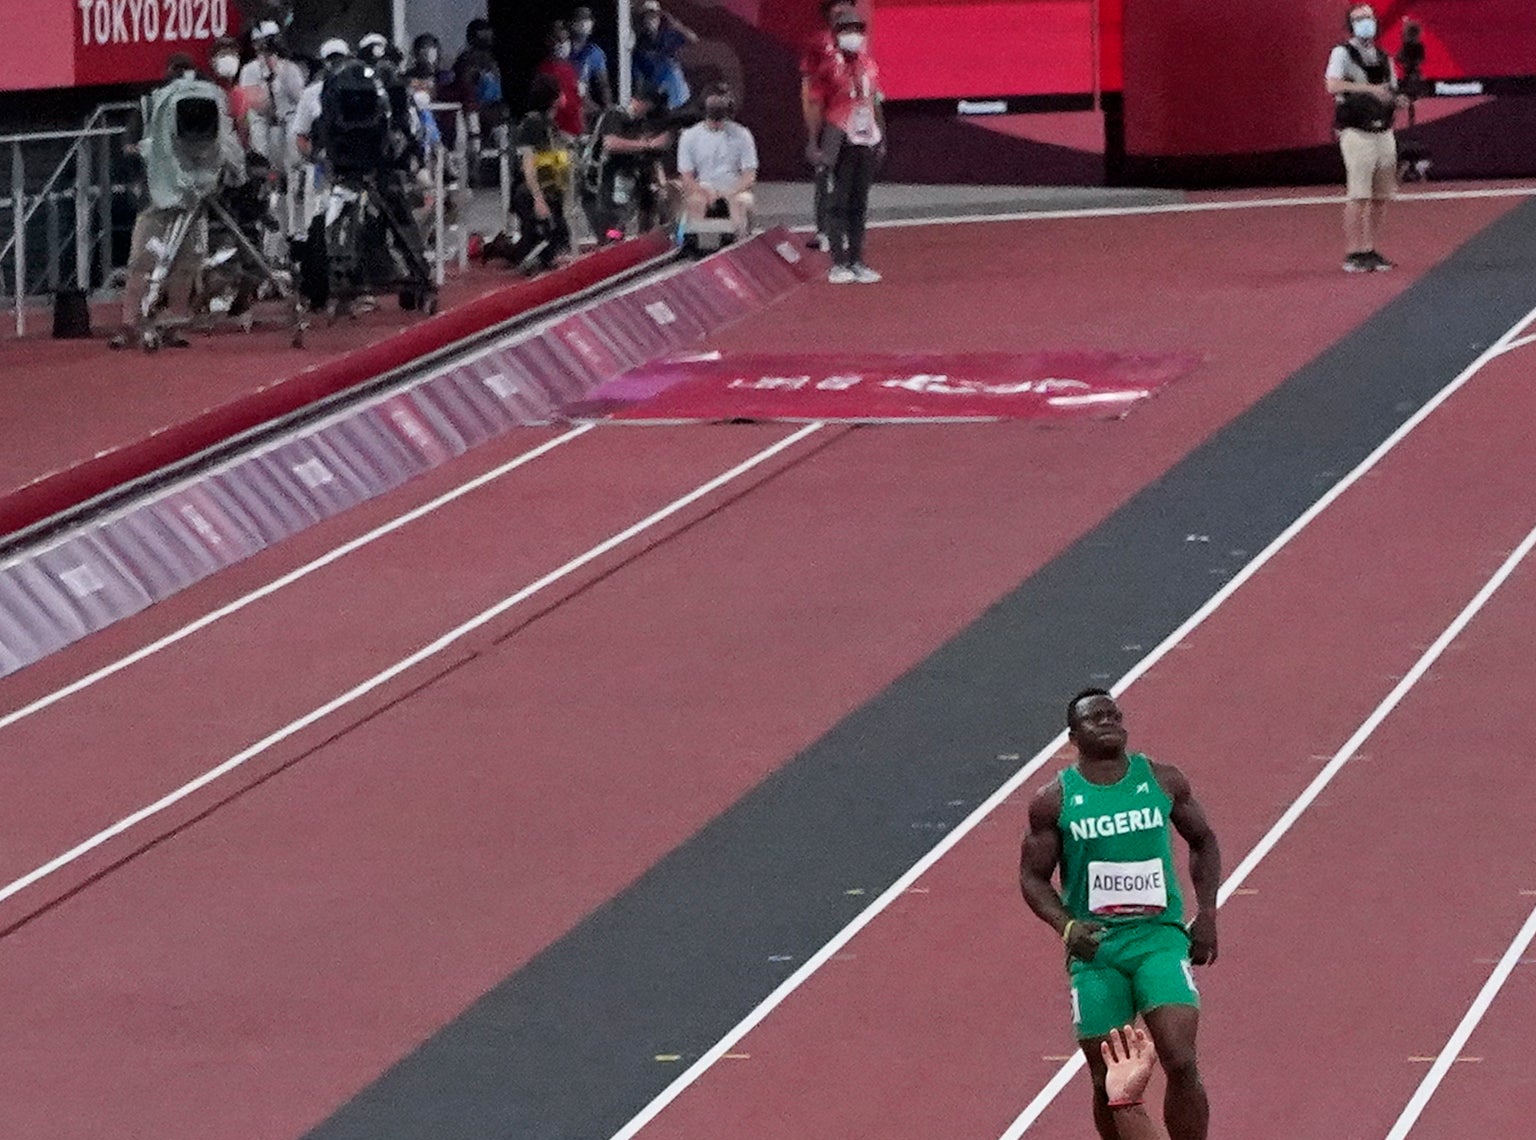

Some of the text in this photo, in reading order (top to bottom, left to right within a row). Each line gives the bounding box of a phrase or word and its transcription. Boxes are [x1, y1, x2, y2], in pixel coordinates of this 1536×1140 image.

[79, 0, 228, 45] TOKYO 2020
[1069, 807, 1164, 842] NIGERIA
[1092, 871, 1162, 892] ADEGOKE
